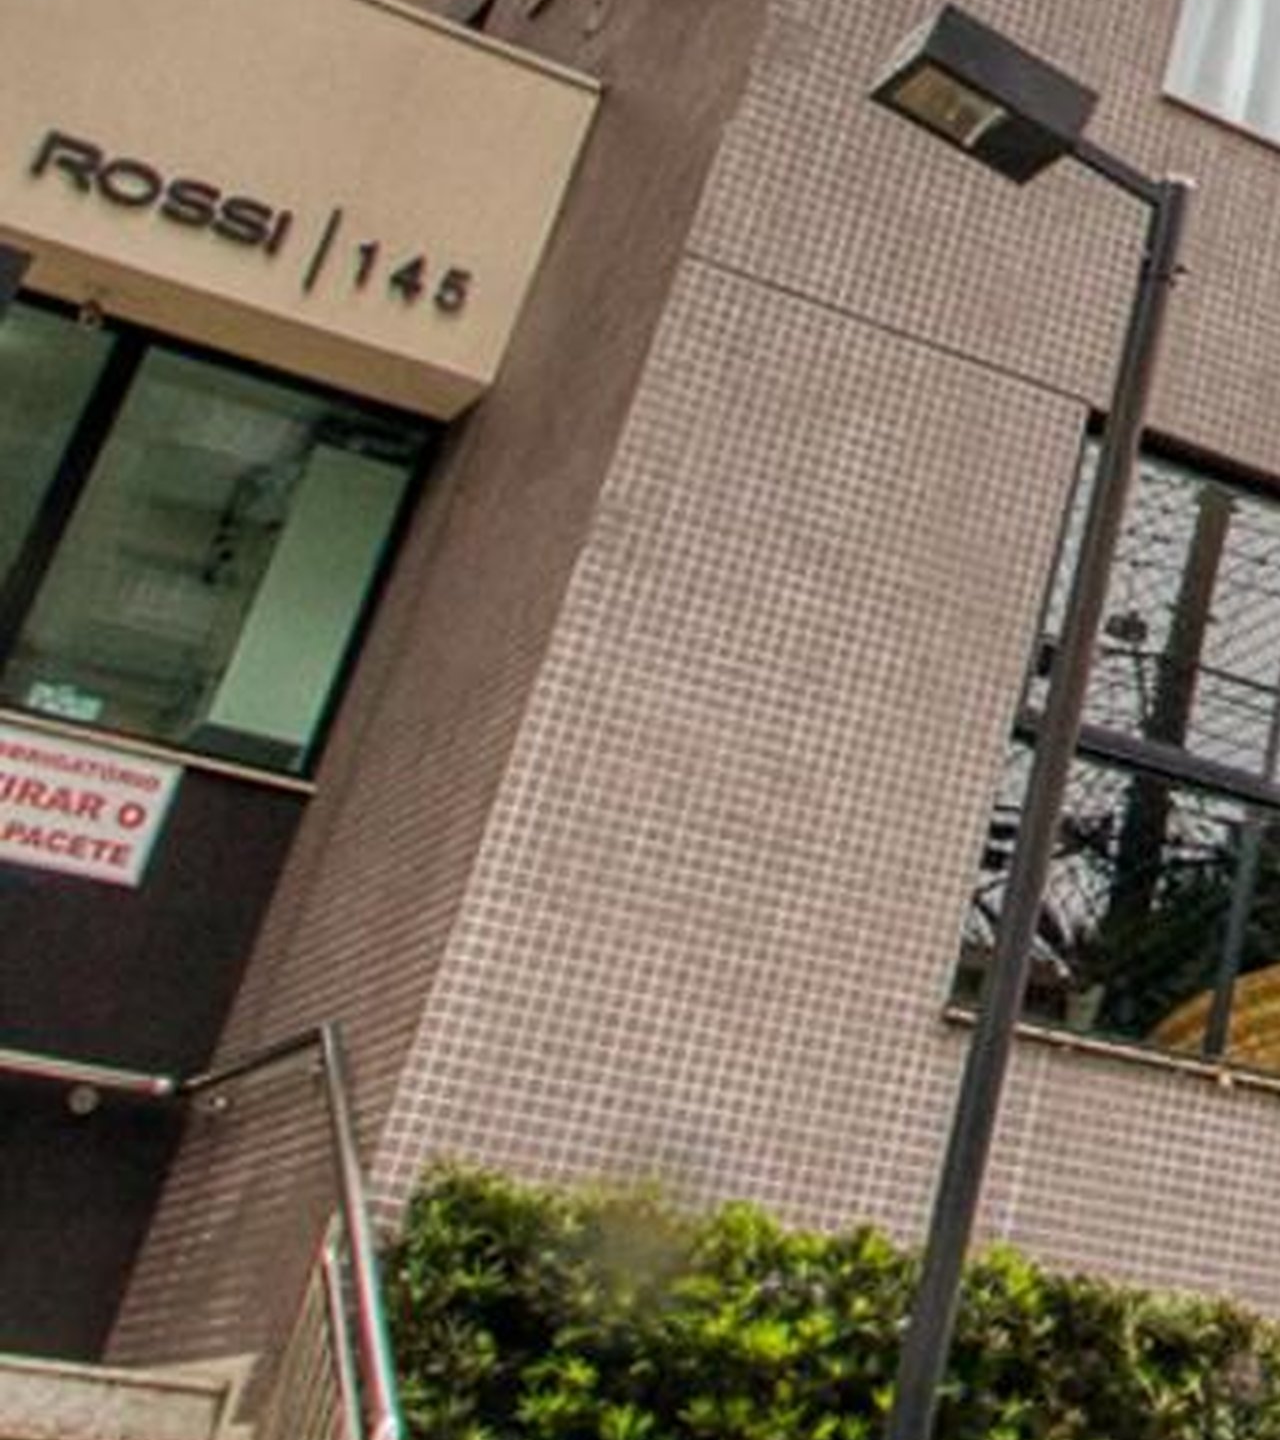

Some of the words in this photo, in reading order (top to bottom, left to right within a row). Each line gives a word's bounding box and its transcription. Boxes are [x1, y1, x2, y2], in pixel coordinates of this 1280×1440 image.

[30, 130, 293, 257] ROSSI
[354, 241, 473, 316] 145
[118, 801, 147, 830] O
[0, 820, 133, 866] PACETE
